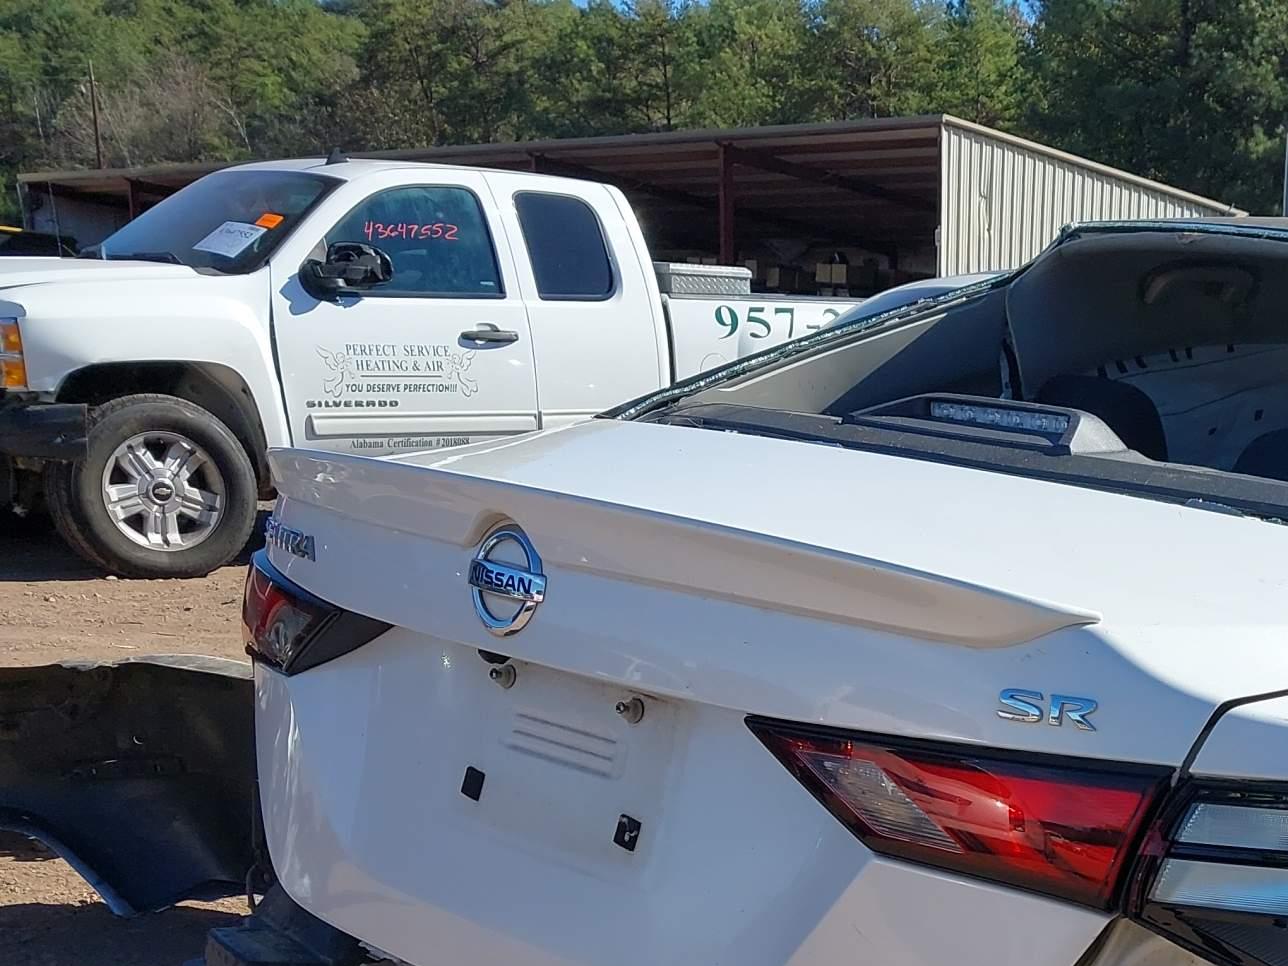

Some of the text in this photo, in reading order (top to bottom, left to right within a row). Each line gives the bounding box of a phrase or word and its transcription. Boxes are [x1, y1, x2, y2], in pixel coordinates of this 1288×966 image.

[364, 221, 459, 240] 43647552
[345, 343, 450, 357] PERFECT SERVICE
[355, 359, 444, 371] HEATING & AIR
[345, 383, 458, 393] YOU DESERVE PERFECTION!!!
[306, 400, 399, 408] SILVERADO
[350, 439, 384, 449] Alabama
[387, 438, 433, 448] Certification
[470, 565, 533, 594] NISSAN
[996, 688, 1098, 732] SR
